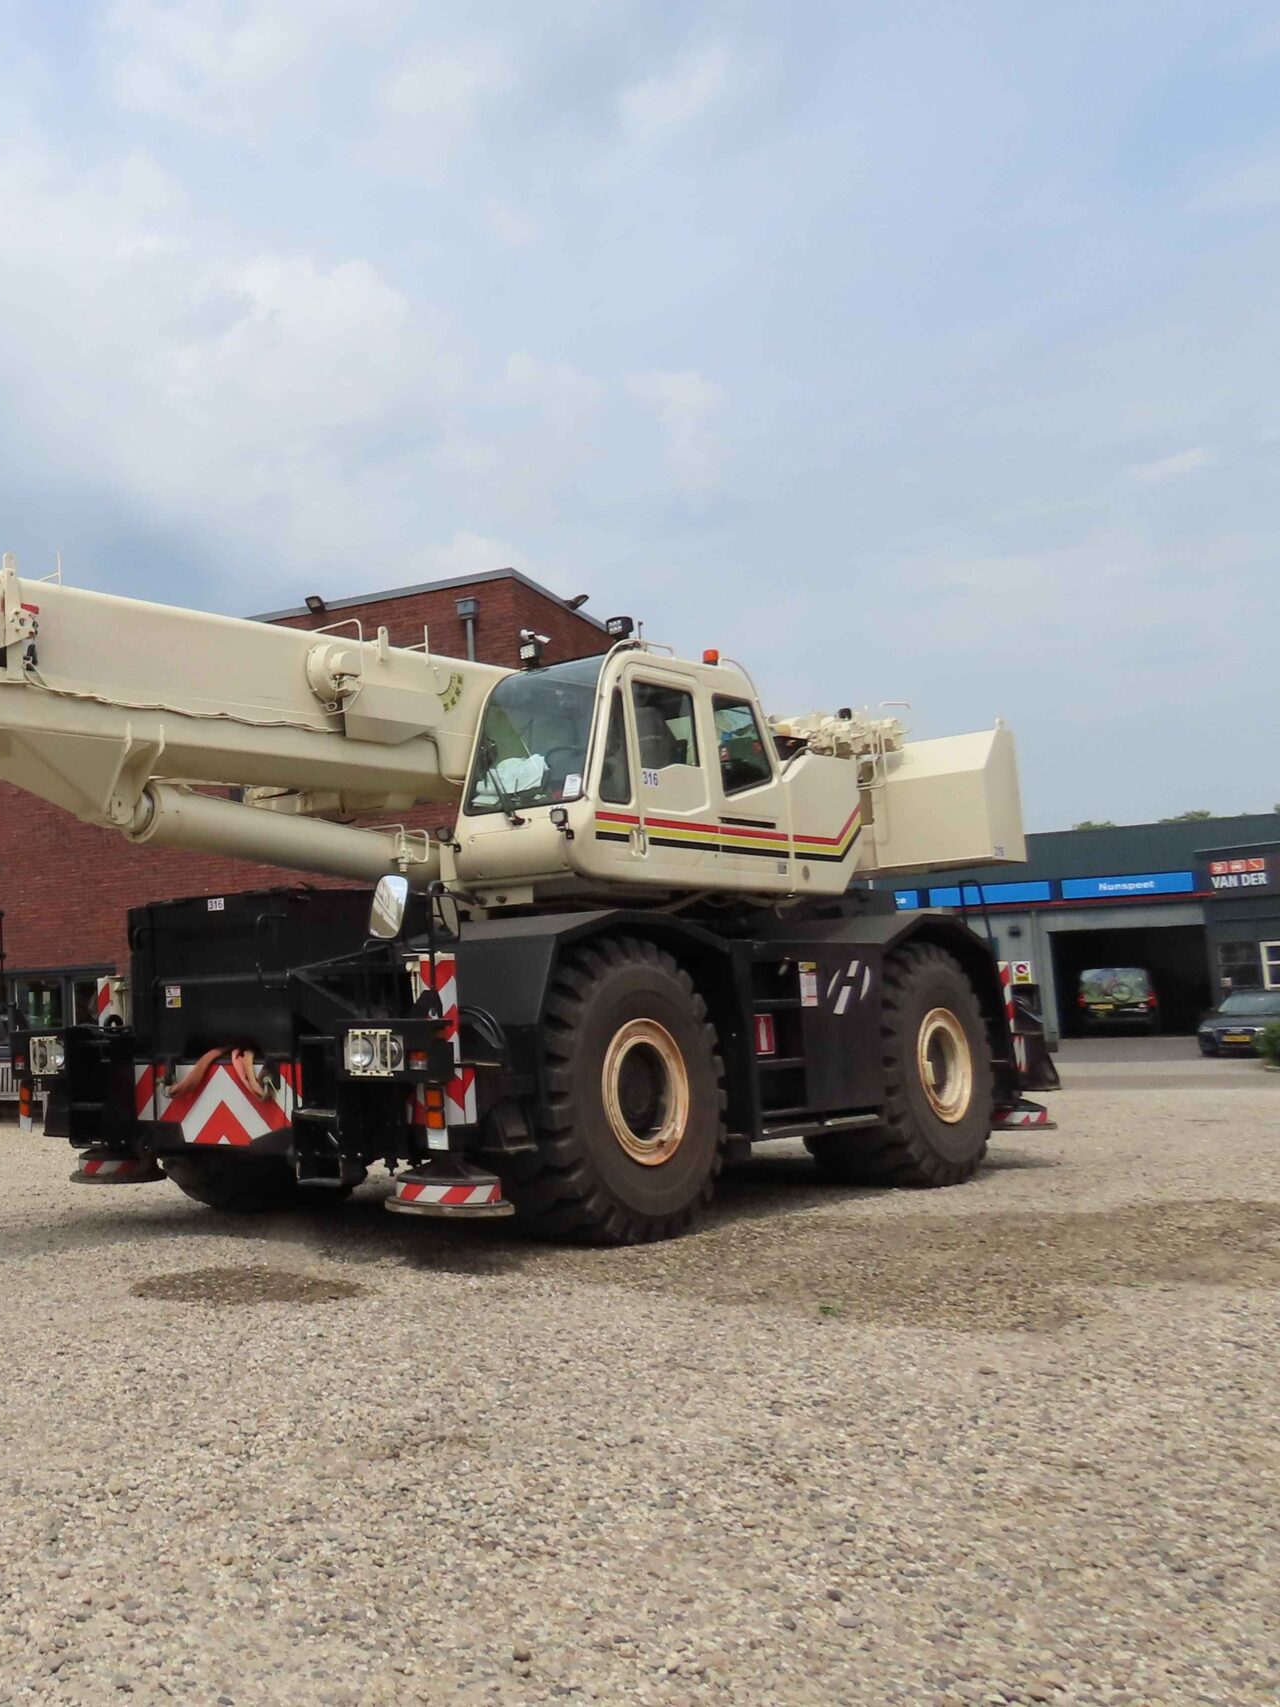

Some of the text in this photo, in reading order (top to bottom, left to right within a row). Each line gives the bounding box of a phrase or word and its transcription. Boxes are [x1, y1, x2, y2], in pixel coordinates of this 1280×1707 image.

[642, 771, 659, 786] 316
[1098, 880, 1155, 891] Nunspeet
[1210, 872, 1268, 889] VAN DER
[208, 899, 224, 910] 316
